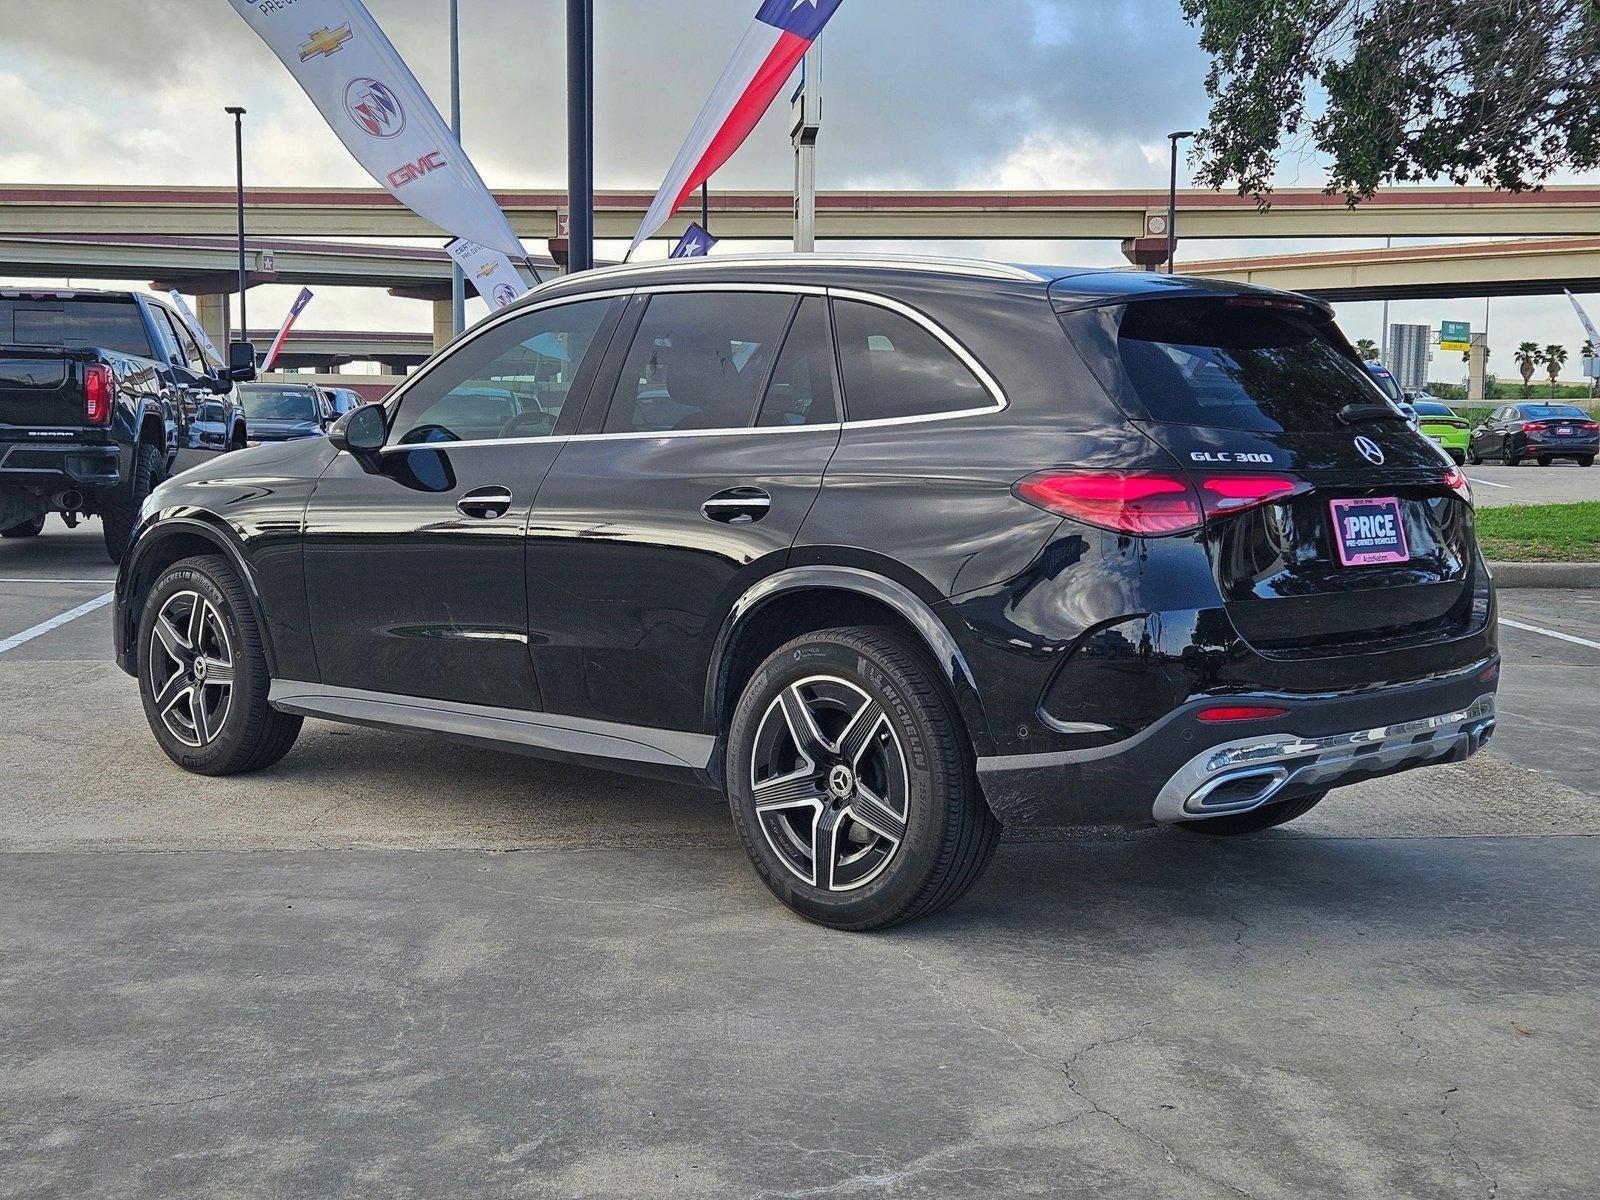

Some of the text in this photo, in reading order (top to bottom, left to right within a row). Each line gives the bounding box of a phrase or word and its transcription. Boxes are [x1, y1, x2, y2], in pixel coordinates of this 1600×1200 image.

[259, 0, 298, 16] PRE-
[386, 149, 447, 188] GMC
[1190, 452, 1274, 463] GLC 300
[1375, 537, 1397, 545] VEHICLES
[882, 685, 926, 767] MICHELIN
